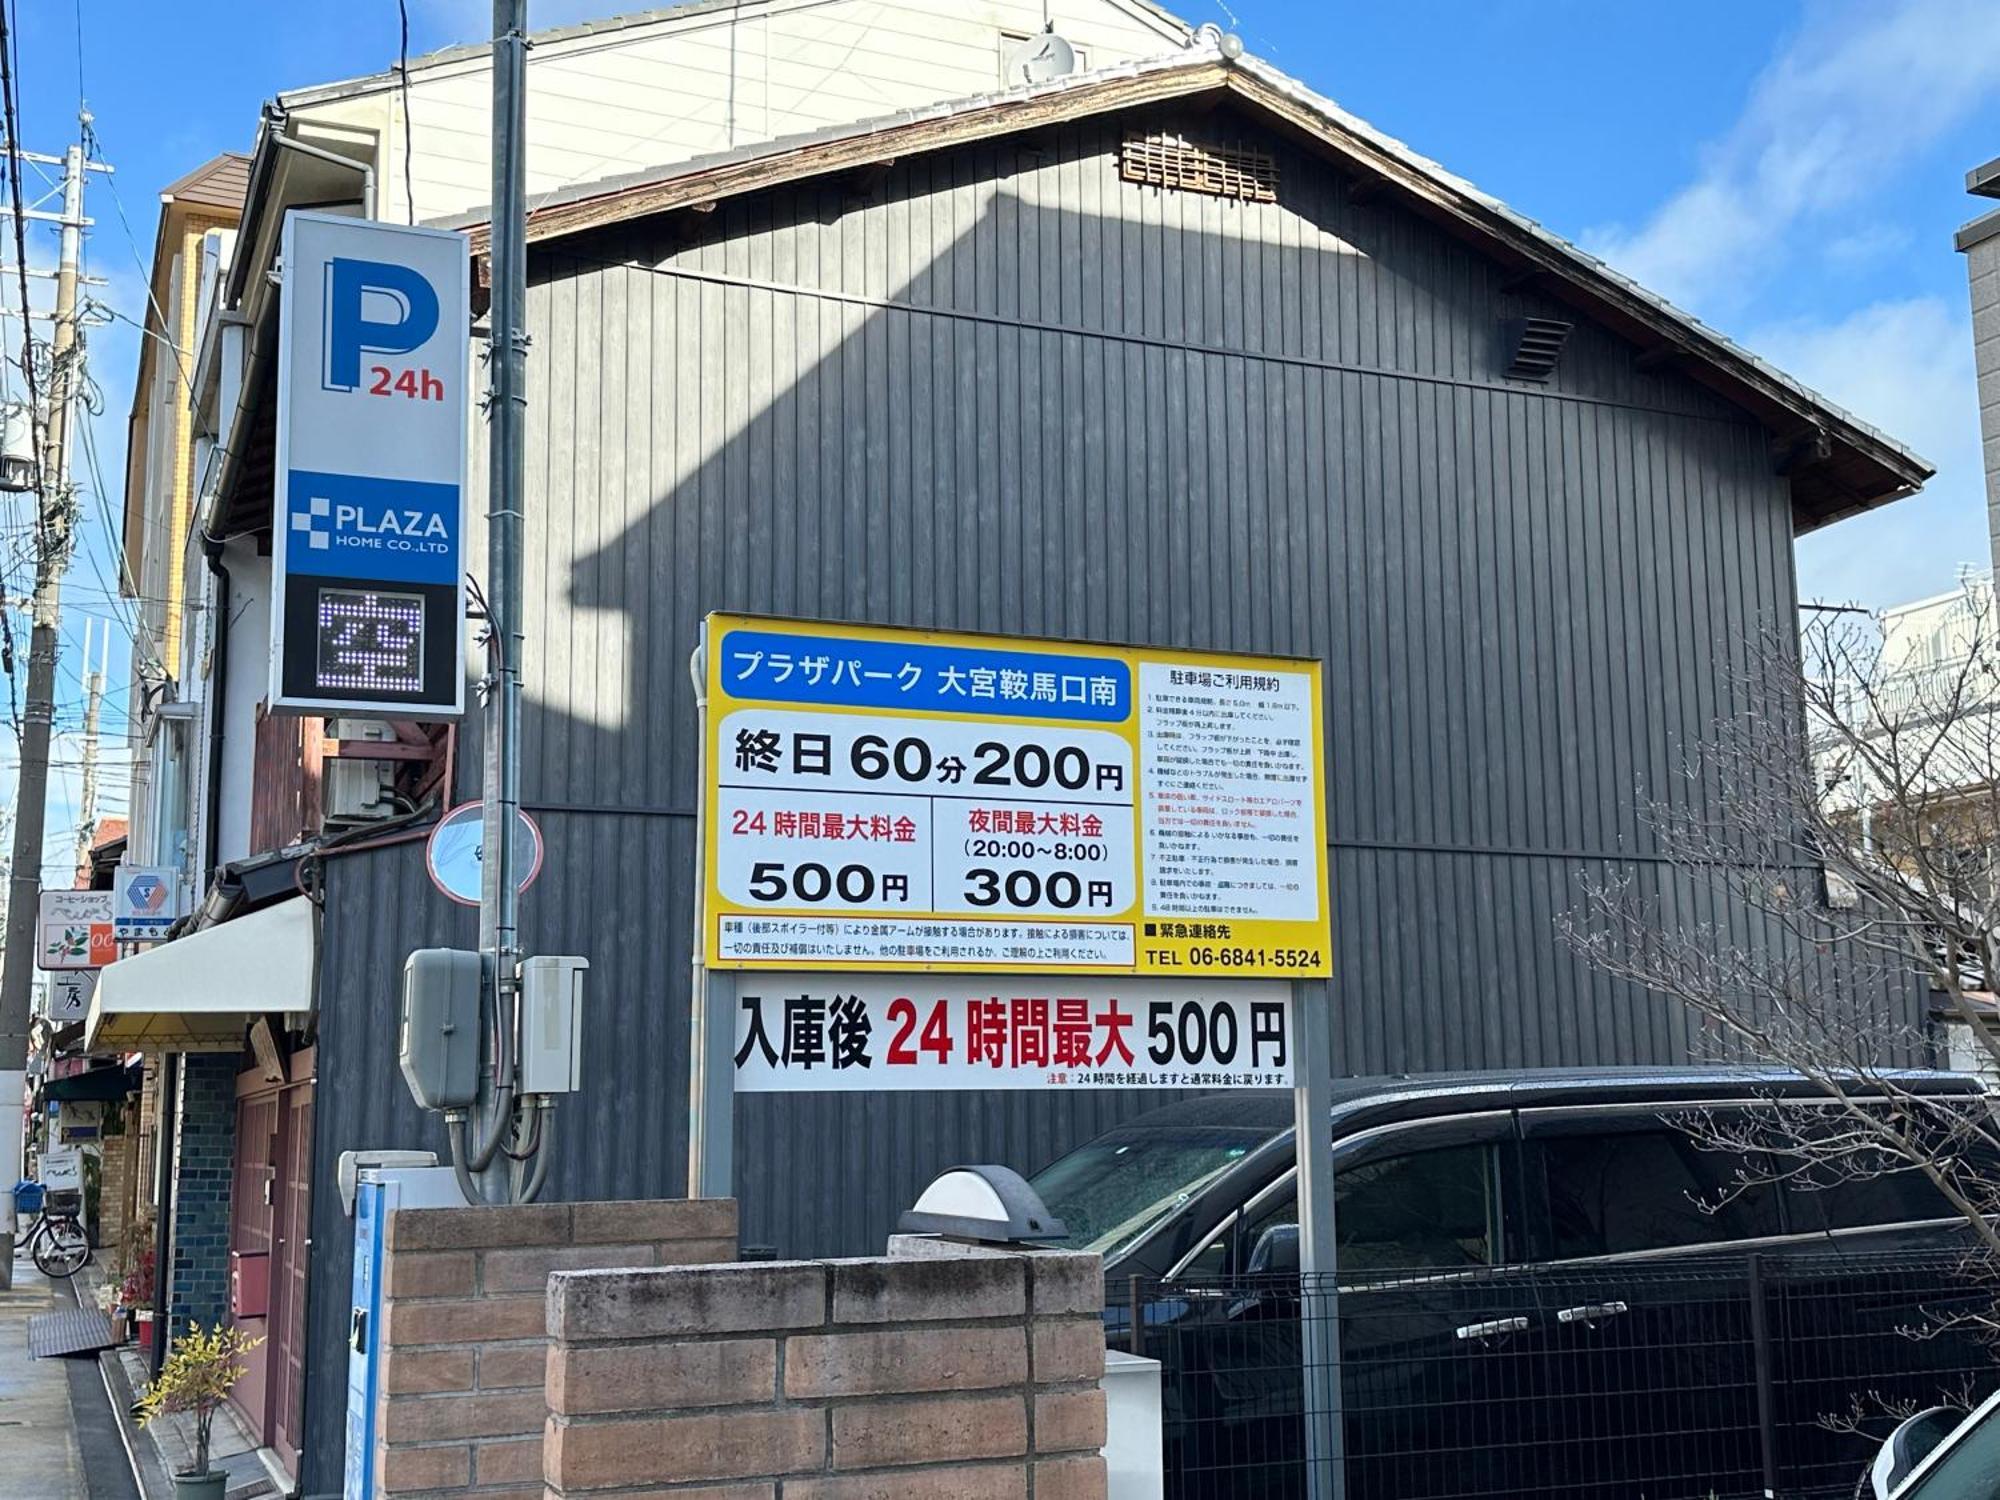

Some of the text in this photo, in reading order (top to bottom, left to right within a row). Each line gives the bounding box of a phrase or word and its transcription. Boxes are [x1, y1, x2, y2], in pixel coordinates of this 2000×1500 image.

[322, 256, 440, 393] P
[370, 366, 445, 401] 24h
[336, 505, 448, 539] PLAZA
[336, 535, 382, 549] HOME
[733, 650, 1118, 707] プラザパーク 大宮鞍馬口南
[1169, 669, 1279, 692] 駐車場ご利用規約
[735, 728, 832, 777] 終日
[968, 807, 1104, 837] 夜間最大料金
[749, 863, 909, 903] 500円
[964, 869, 1113, 909] 300円
[1161, 923, 1231, 939] 緊急連絡先
[1146, 947, 1321, 967] TEL 06-6841-5524
[734, 994, 873, 1071] 入庫後
